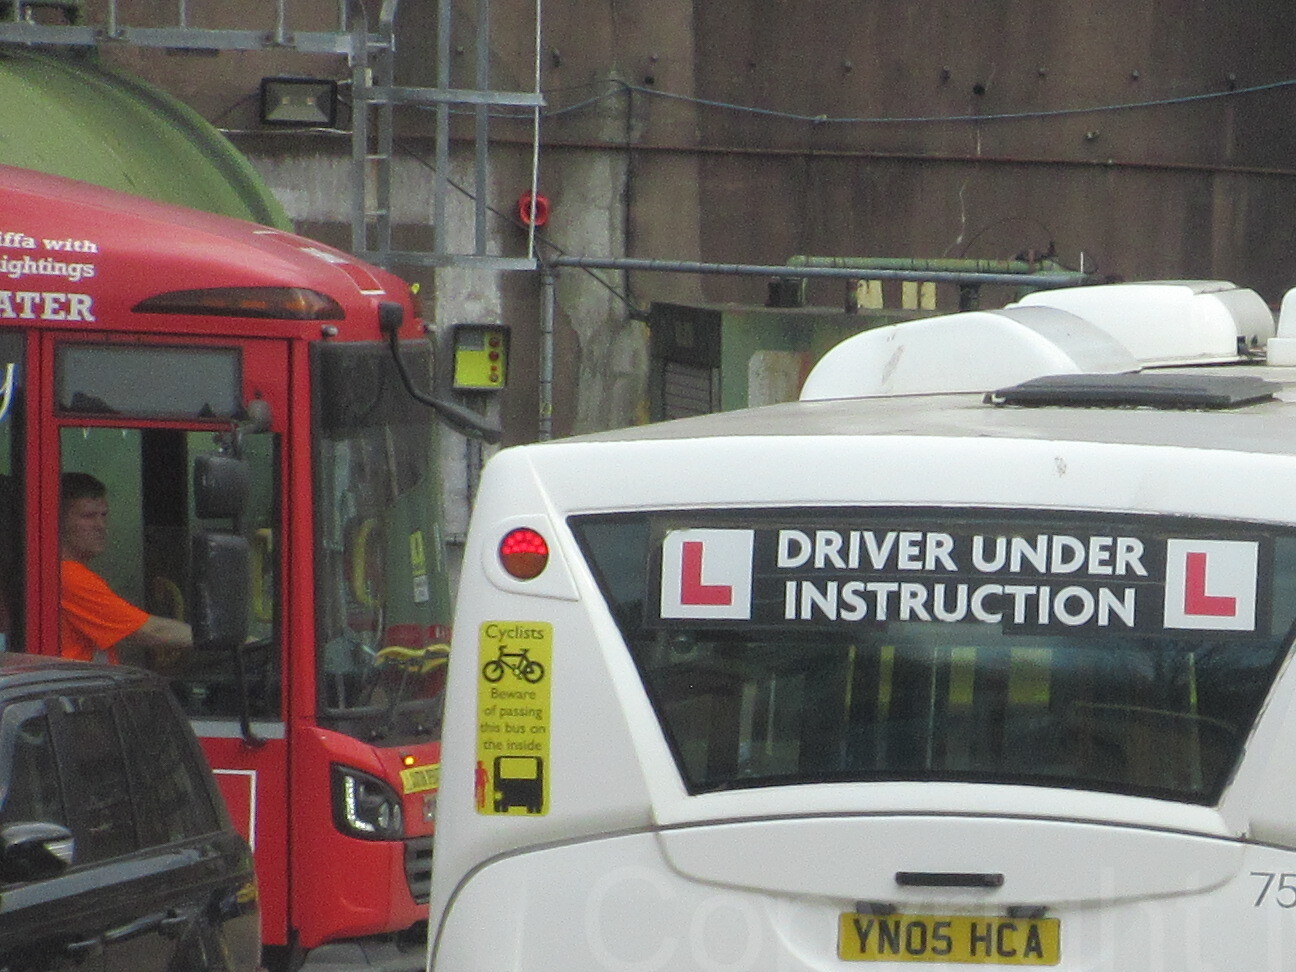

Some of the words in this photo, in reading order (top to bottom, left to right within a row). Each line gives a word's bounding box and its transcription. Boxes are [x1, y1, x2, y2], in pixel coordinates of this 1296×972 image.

[42, 238, 98, 253] with
[777, 529, 958, 571] DRIVER
[972, 534, 1148, 577] UNDER
[681, 541, 732, 605] L
[1184, 552, 1236, 617] L
[785, 581, 1136, 627] INSTRUCTION
[486, 624, 545, 643] Cyclists
[491, 687, 536, 700] Beware
[484, 706, 496, 717] of
[500, 707, 543, 720] passing
[480, 723, 500, 734] this
[505, 723, 525, 734] bus
[530, 725, 546, 734] on
[483, 740, 502, 750] the
[507, 740, 542, 750] inside
[853, 918, 953, 956] YN05
[970, 921, 1044, 959] HCA
